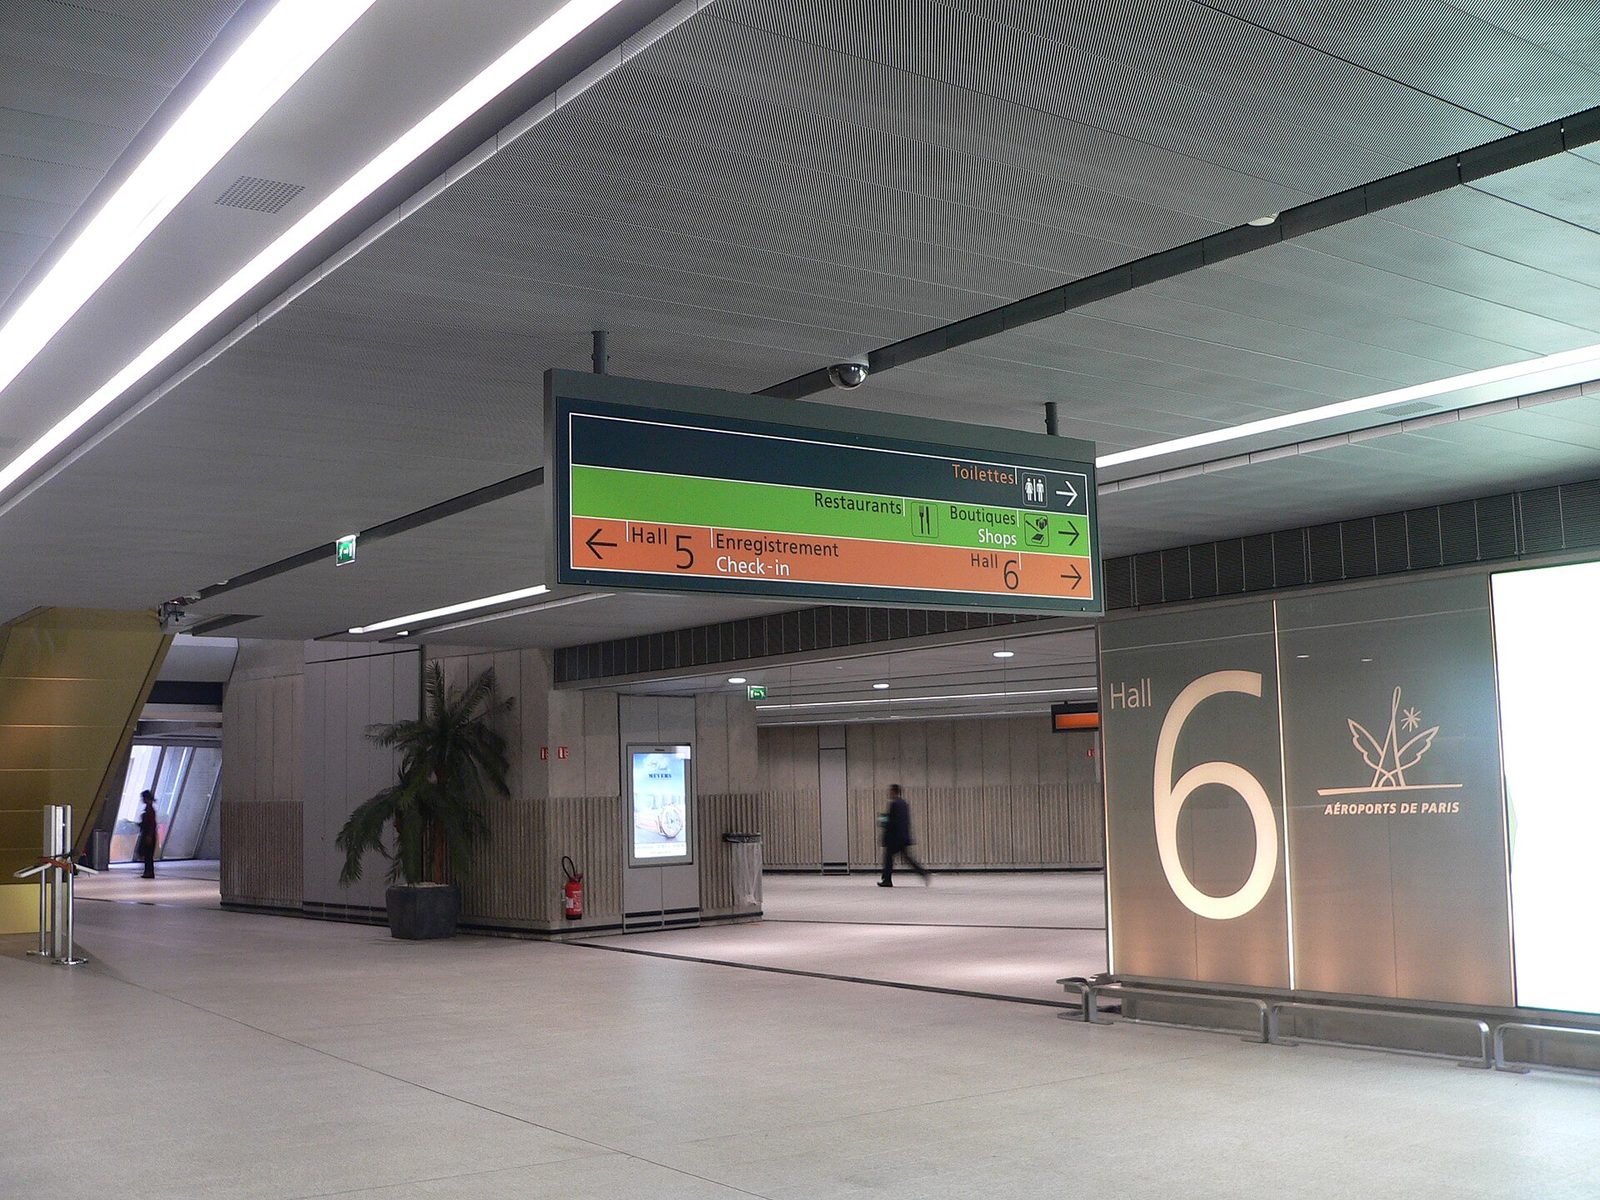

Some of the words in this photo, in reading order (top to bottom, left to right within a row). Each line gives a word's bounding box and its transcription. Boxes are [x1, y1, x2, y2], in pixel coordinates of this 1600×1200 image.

[952, 464, 1014, 484] Toilettes
[815, 492, 902, 514] Restaurants
[950, 506, 1016, 527] Boutiques
[632, 527, 667, 545] Hall
[676, 535, 694, 569] 5
[716, 533, 839, 557] Enregistrement
[978, 528, 1017, 548] Shops
[716, 556, 790, 576] Check-in
[971, 553, 998, 569] Hall
[1003, 560, 1019, 590] 6
[1110, 678, 1151, 710] Hall
[1154, 670, 1278, 920] 6
[1324, 802, 1397, 815] AÉROPORTS
[1400, 803, 1418, 814] DE
[1421, 802, 1460, 814] PARIS
